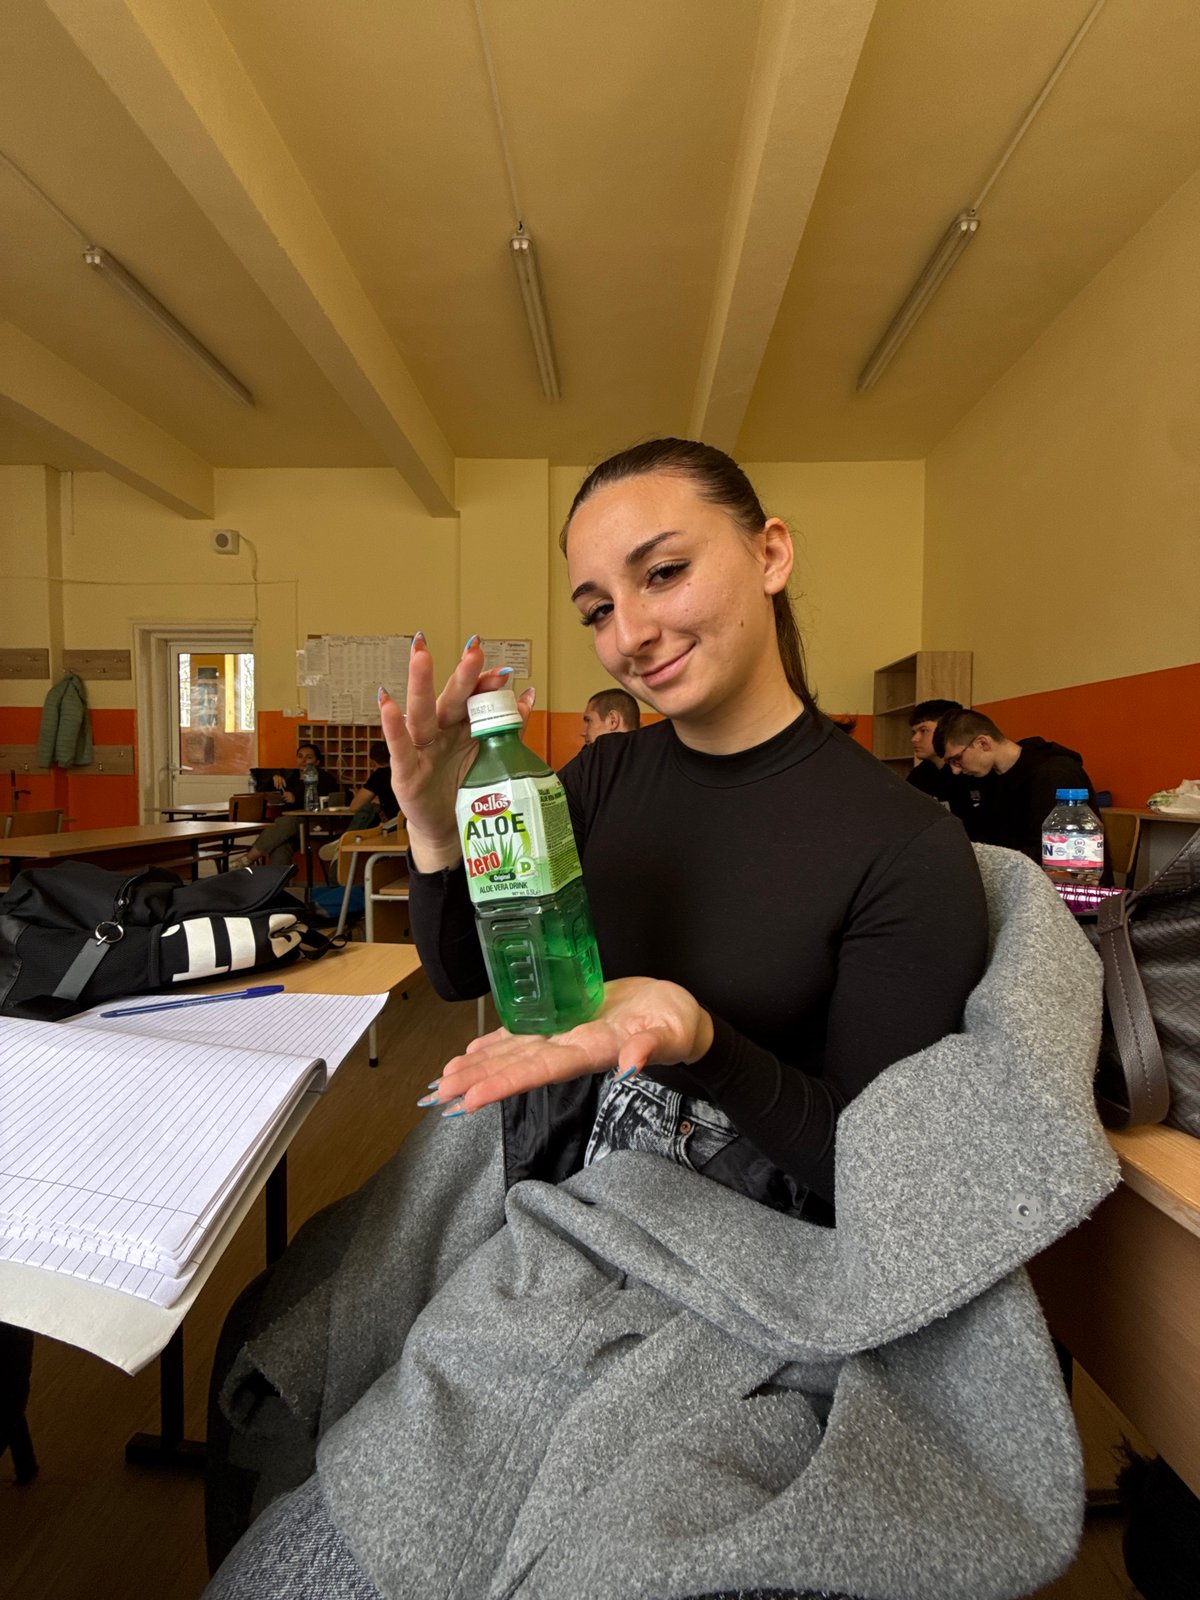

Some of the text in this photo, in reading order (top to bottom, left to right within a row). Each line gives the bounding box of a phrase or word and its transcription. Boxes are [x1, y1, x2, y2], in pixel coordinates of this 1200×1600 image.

[474, 794, 509, 813] Dellos
[467, 813, 526, 841] ALOE
[480, 881, 528, 894] ALOE VERA DRINK
